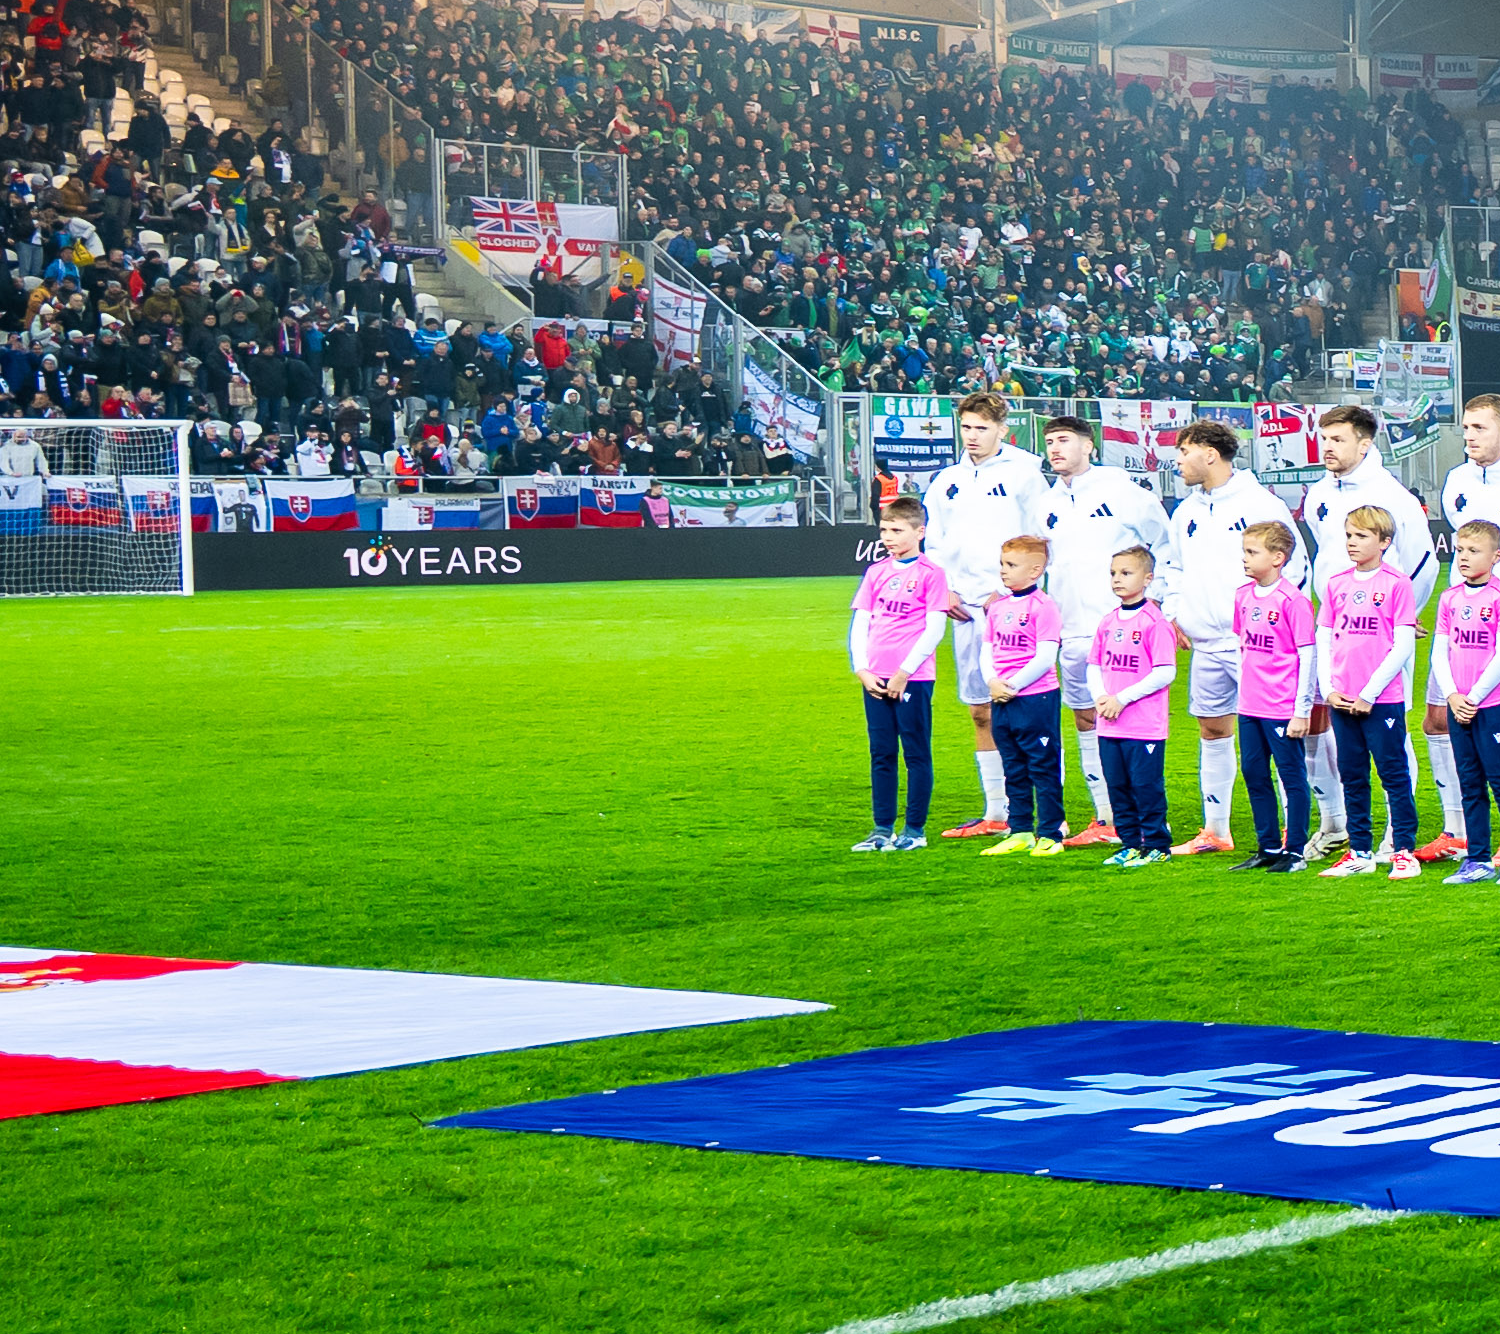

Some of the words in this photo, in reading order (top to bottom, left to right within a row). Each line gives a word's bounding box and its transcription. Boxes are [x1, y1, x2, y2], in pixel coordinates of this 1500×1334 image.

[1012, 37, 1033, 51] CITY
[1036, 42, 1046, 53] OF
[1211, 50, 1293, 63] EVERYWHERE
[1297, 54, 1315, 63] WE
[1319, 53, 1336, 63] GO
[1380, 57, 1422, 72] SCARVA
[1437, 61, 1472, 73] LOYAL
[480, 236, 537, 249] CLOGHER
[577, 242, 620, 253] VALY
[884, 397, 941, 416] GAWA
[592, 478, 637, 490] ĎANOVÁ
[662, 482, 791, 501] COOKSTOWN
[391, 546, 522, 576] YEARS
